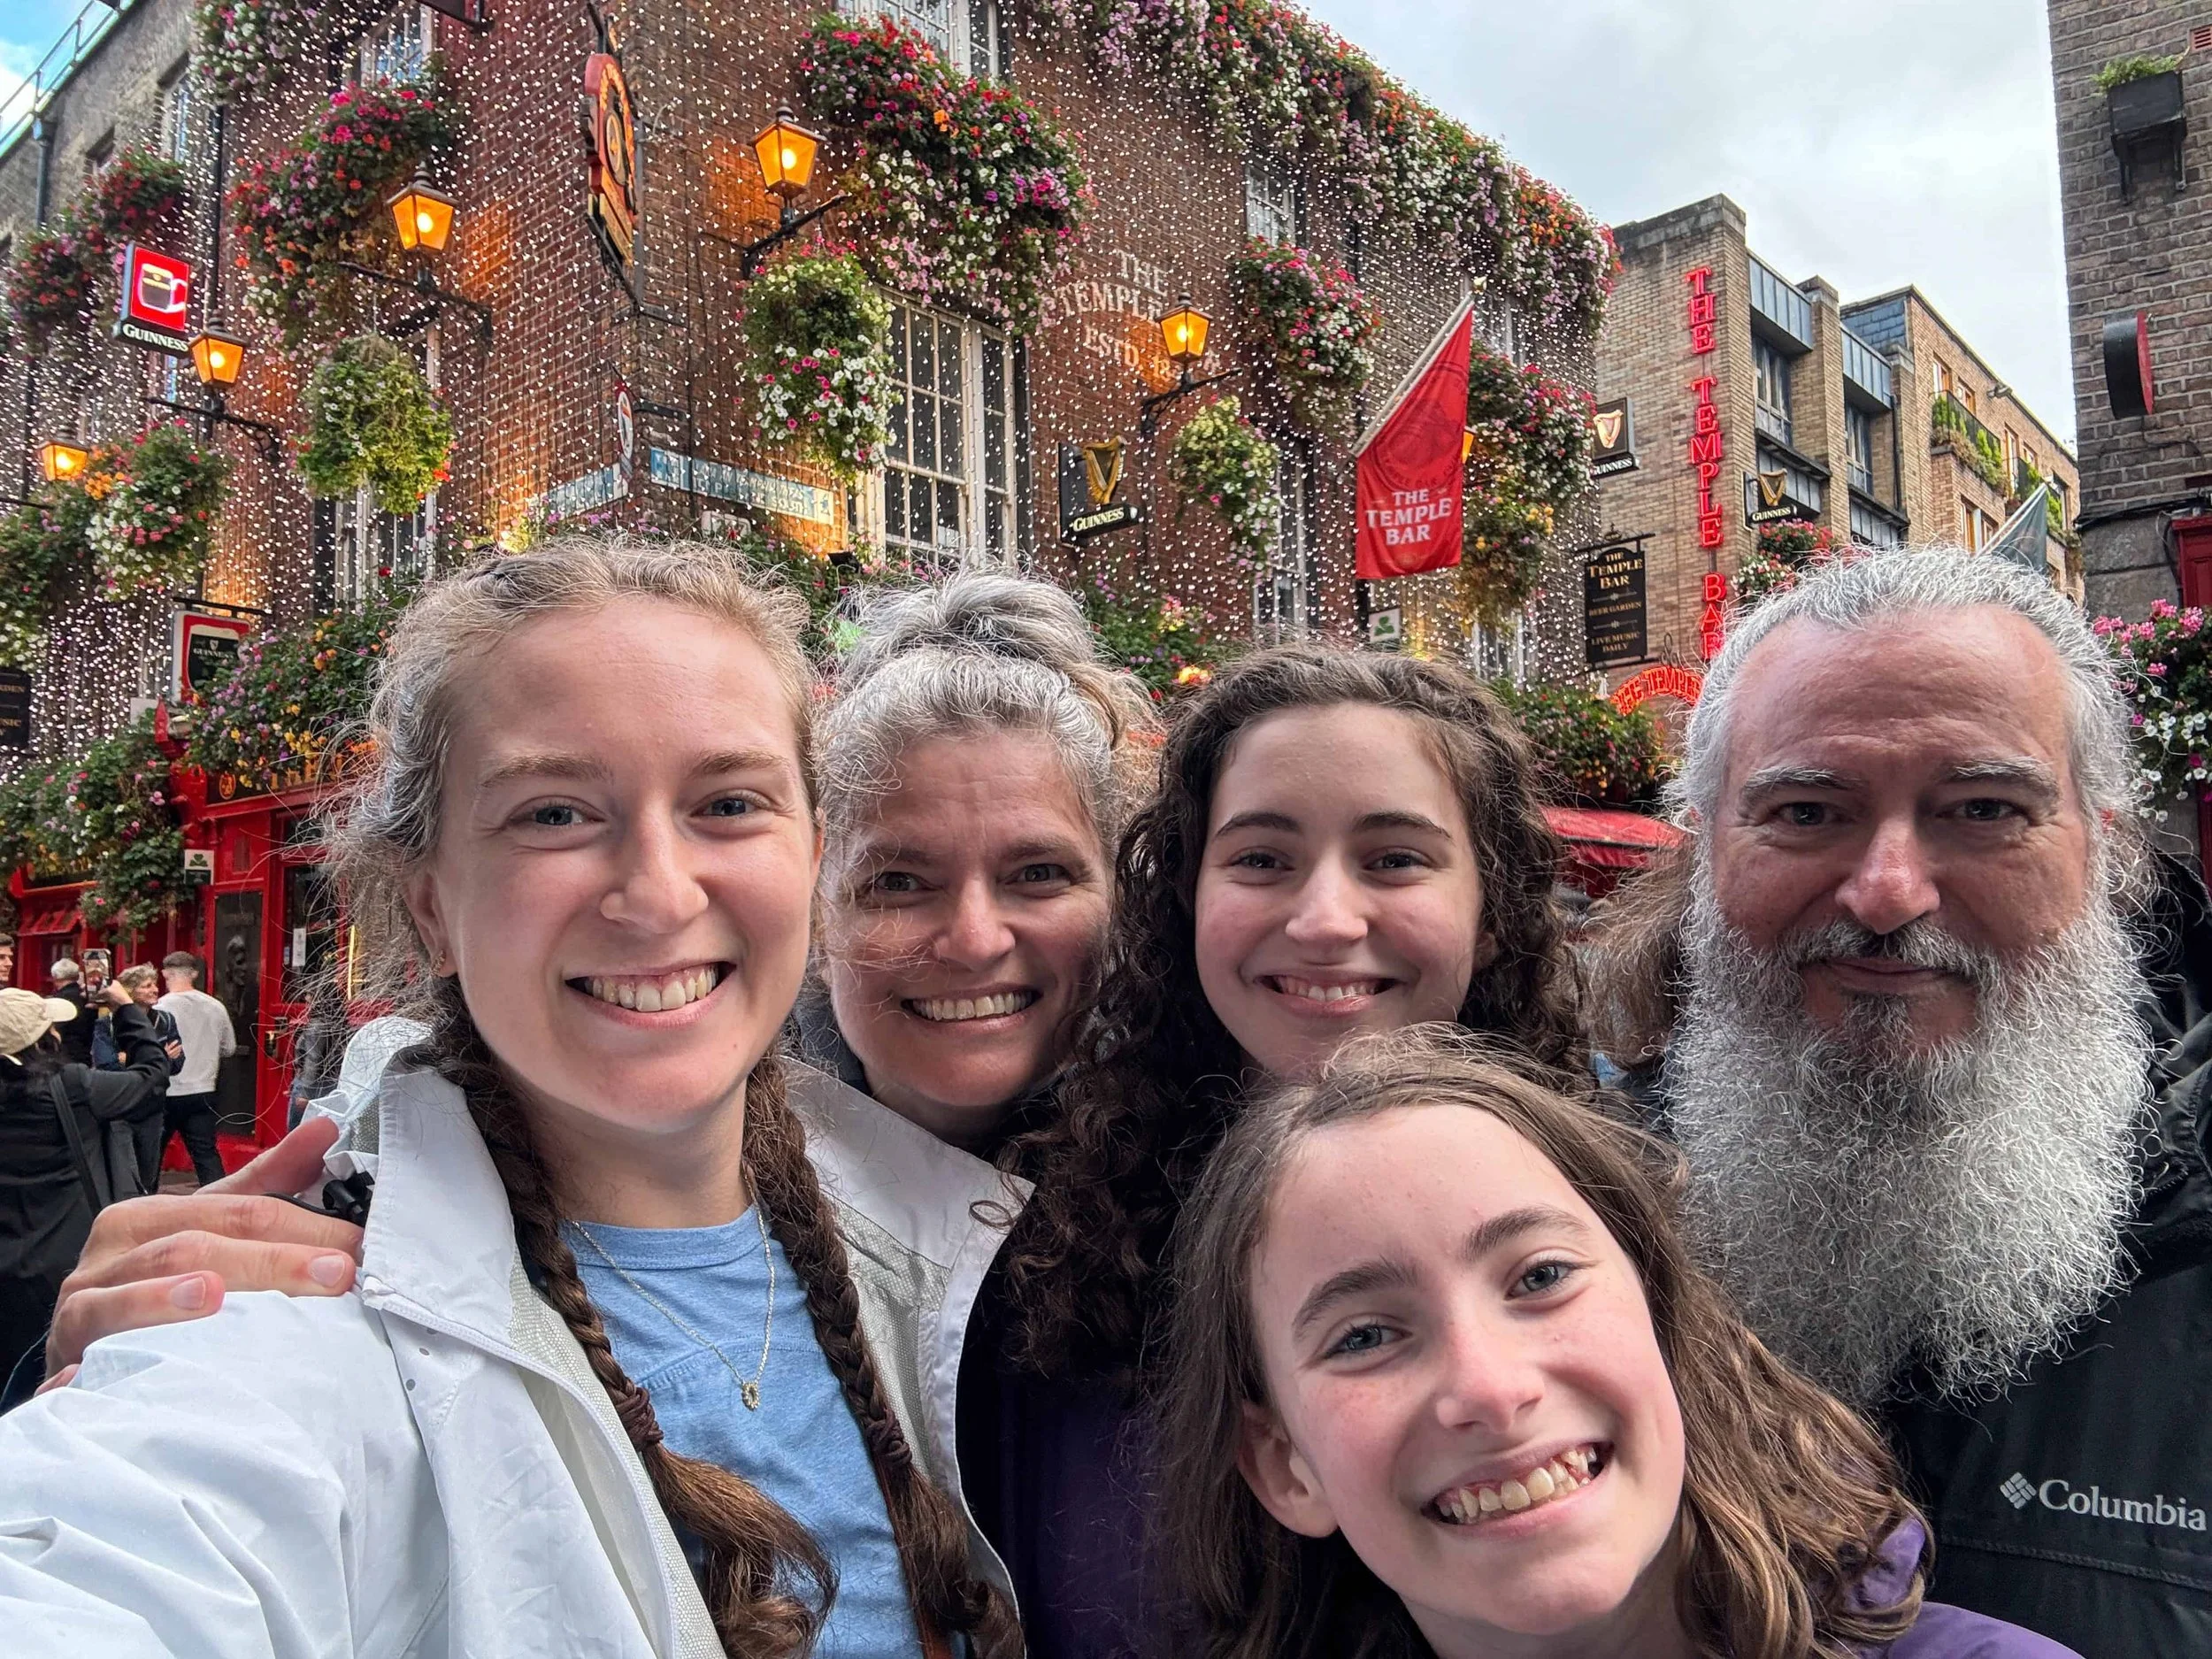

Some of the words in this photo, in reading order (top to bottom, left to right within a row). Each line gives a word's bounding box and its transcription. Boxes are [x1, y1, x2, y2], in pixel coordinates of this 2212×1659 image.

[1116, 249, 1168, 297] THE
[1685, 267, 1717, 354] THE
[122, 323, 189, 352] GUINNESS
[1594, 457, 1633, 476] UINNESS
[1689, 376, 1724, 549] TEMPLE
[1392, 488, 1430, 508] THE
[1072, 506, 1125, 532] GUINNESS
[1365, 497, 1453, 528] TEMPLE
[1752, 506, 1792, 522] GUINNESS
[1385, 524, 1431, 546] BAR
[1589, 558, 1644, 578] TEMPLE
[1605, 551, 1624, 563] THE
[1600, 574, 1631, 589] BAR
[1609, 601, 1642, 613] GARDEN
[1701, 572, 1727, 660] BAR
[2039, 1479, 2208, 1532] Columbia
